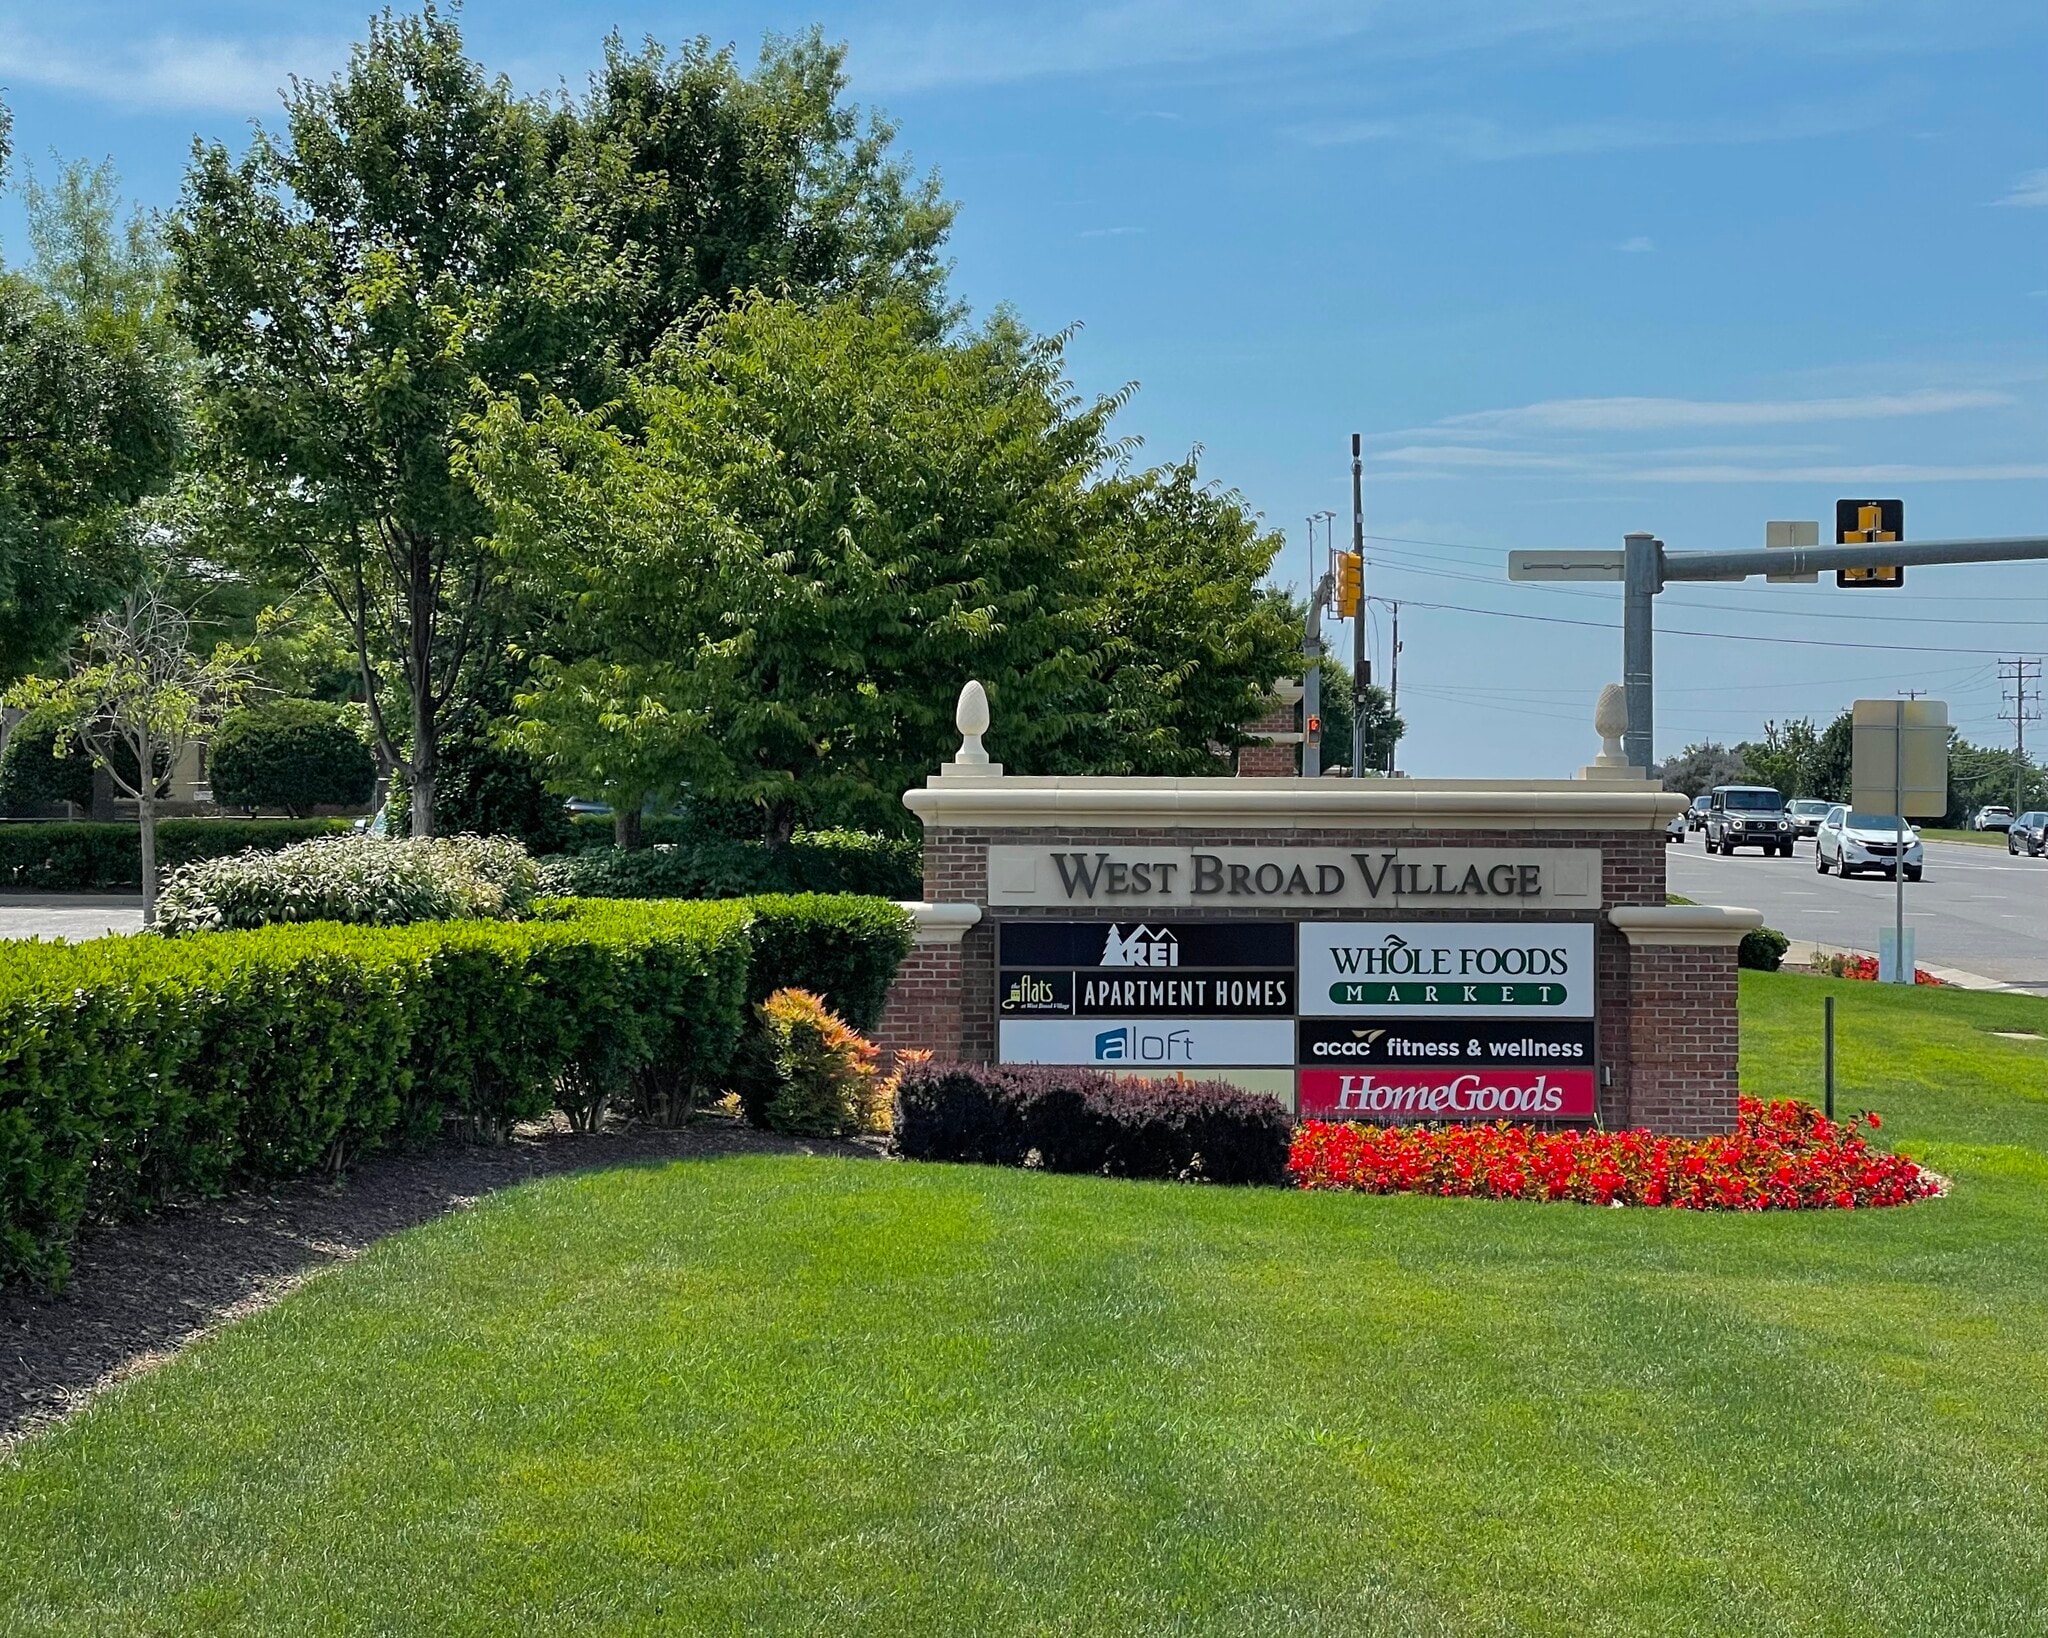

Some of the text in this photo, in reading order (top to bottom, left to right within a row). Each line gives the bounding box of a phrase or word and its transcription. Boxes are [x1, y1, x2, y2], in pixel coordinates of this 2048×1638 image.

[1329, 946, 1569, 976] WHOLE FOODS
[1021, 975, 1053, 1003] flats
[1084, 980, 1287, 1007] APARTMENT HOMES
[1345, 985, 1552, 1002] MARKET
[1095, 1026, 1194, 1061] aloft
[1312, 1038, 1584, 1057] acac fitness & wellness
[1334, 1074, 1563, 1112] HomeGoods
